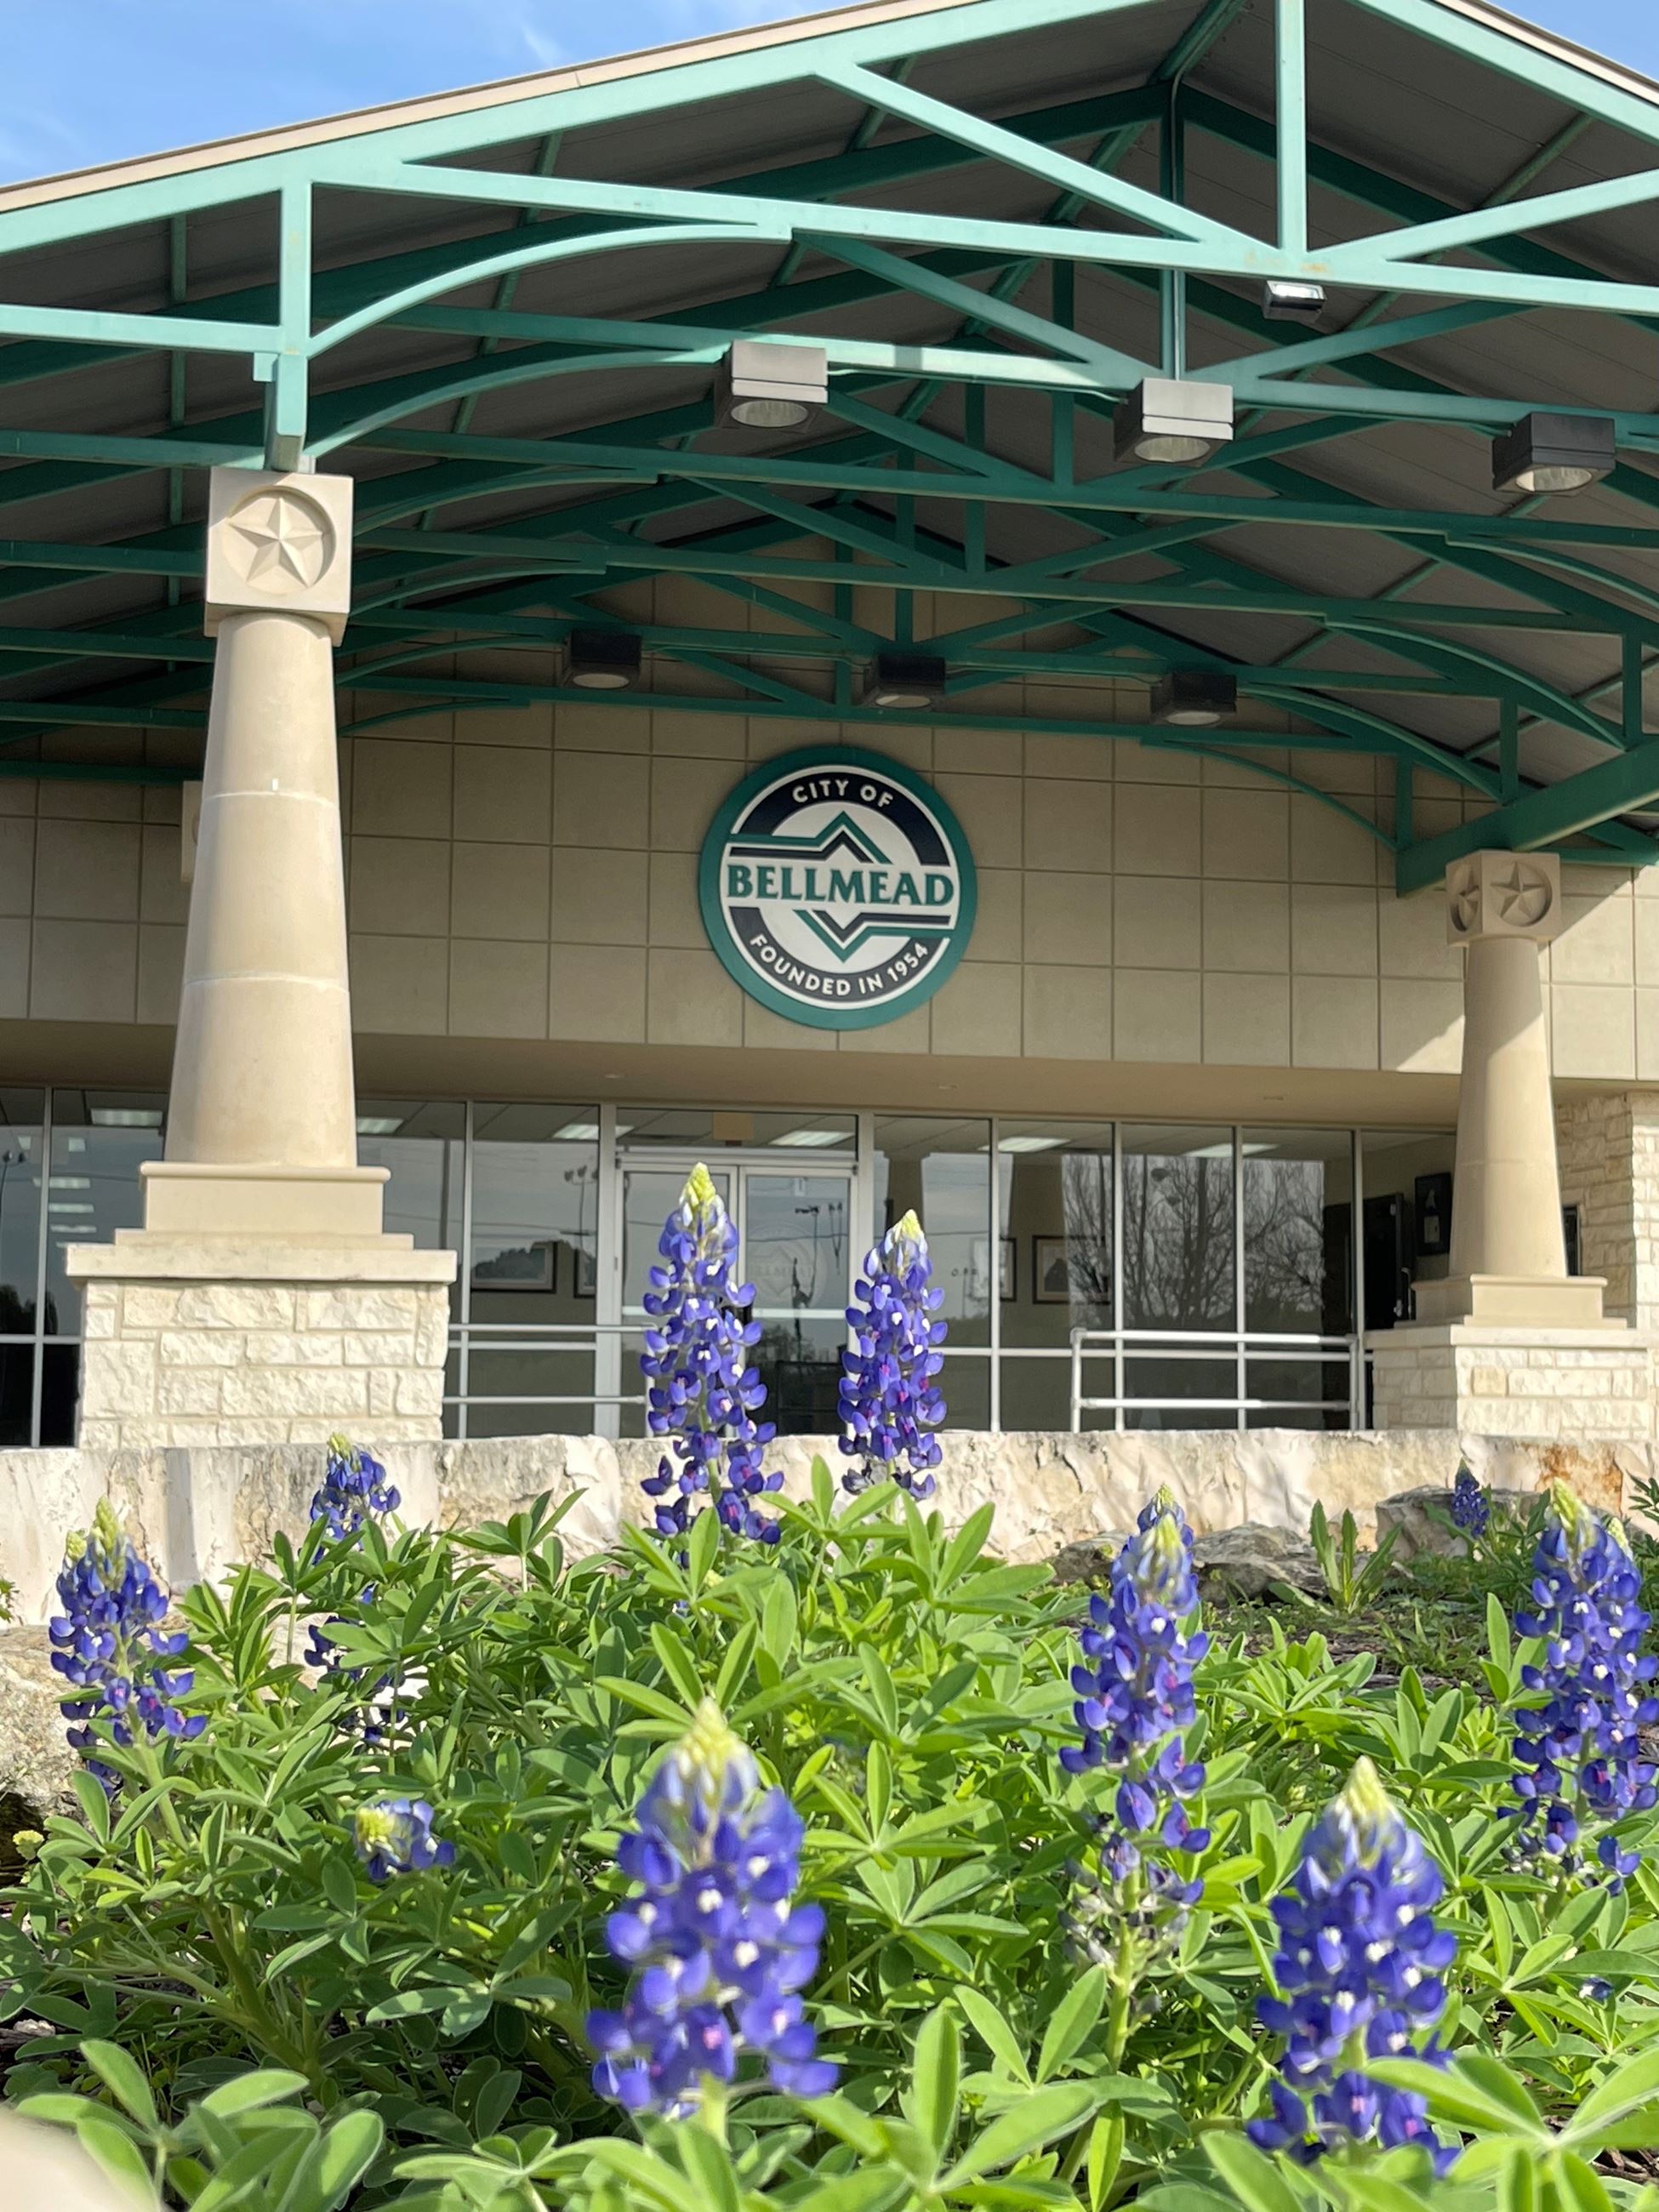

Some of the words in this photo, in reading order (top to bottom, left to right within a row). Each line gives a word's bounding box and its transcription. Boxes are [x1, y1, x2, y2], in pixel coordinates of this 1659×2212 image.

[792, 779, 849, 803] CITY
[859, 784, 893, 807] OF
[727, 864, 955, 907] BELLMEAD
[750, 934, 851, 996] FOUNDED
[858, 971, 883, 994] IN
[887, 943, 928, 982] 1954
